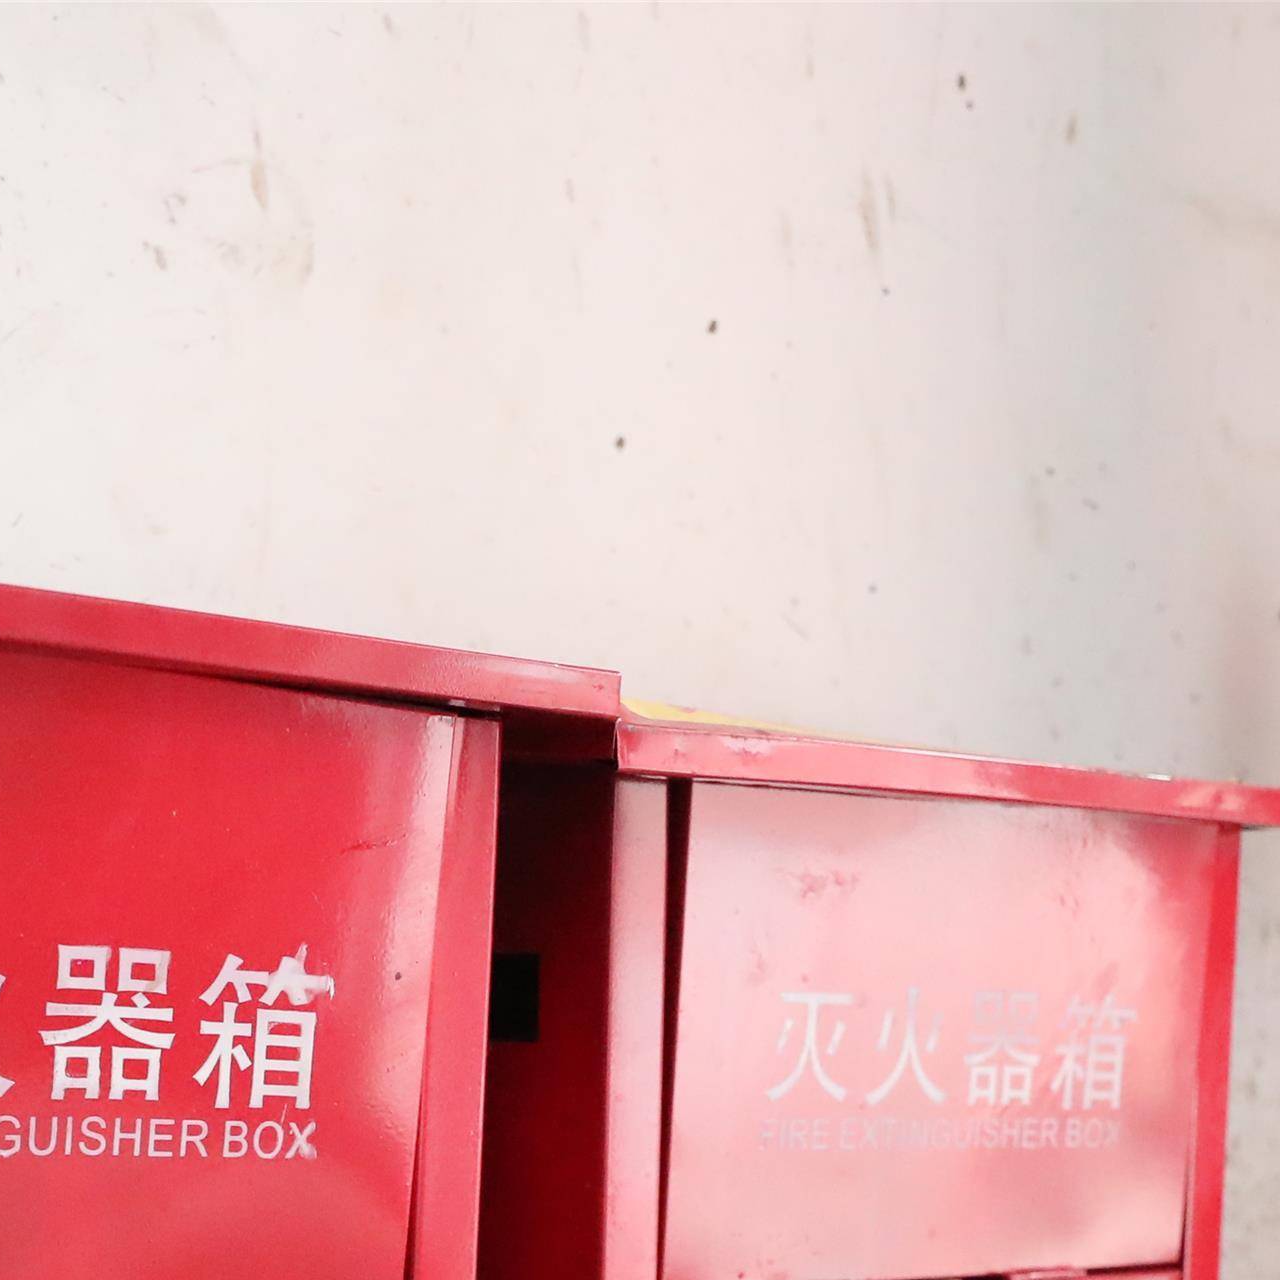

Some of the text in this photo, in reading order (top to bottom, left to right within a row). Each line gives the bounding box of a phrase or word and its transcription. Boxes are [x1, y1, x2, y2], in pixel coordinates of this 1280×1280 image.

[765, 986, 1138, 1110] 灭火器箱
[223, 1120, 317, 1160] BOX
[758, 1117, 1120, 1151] FIRE EXTINGUISHER BOX
